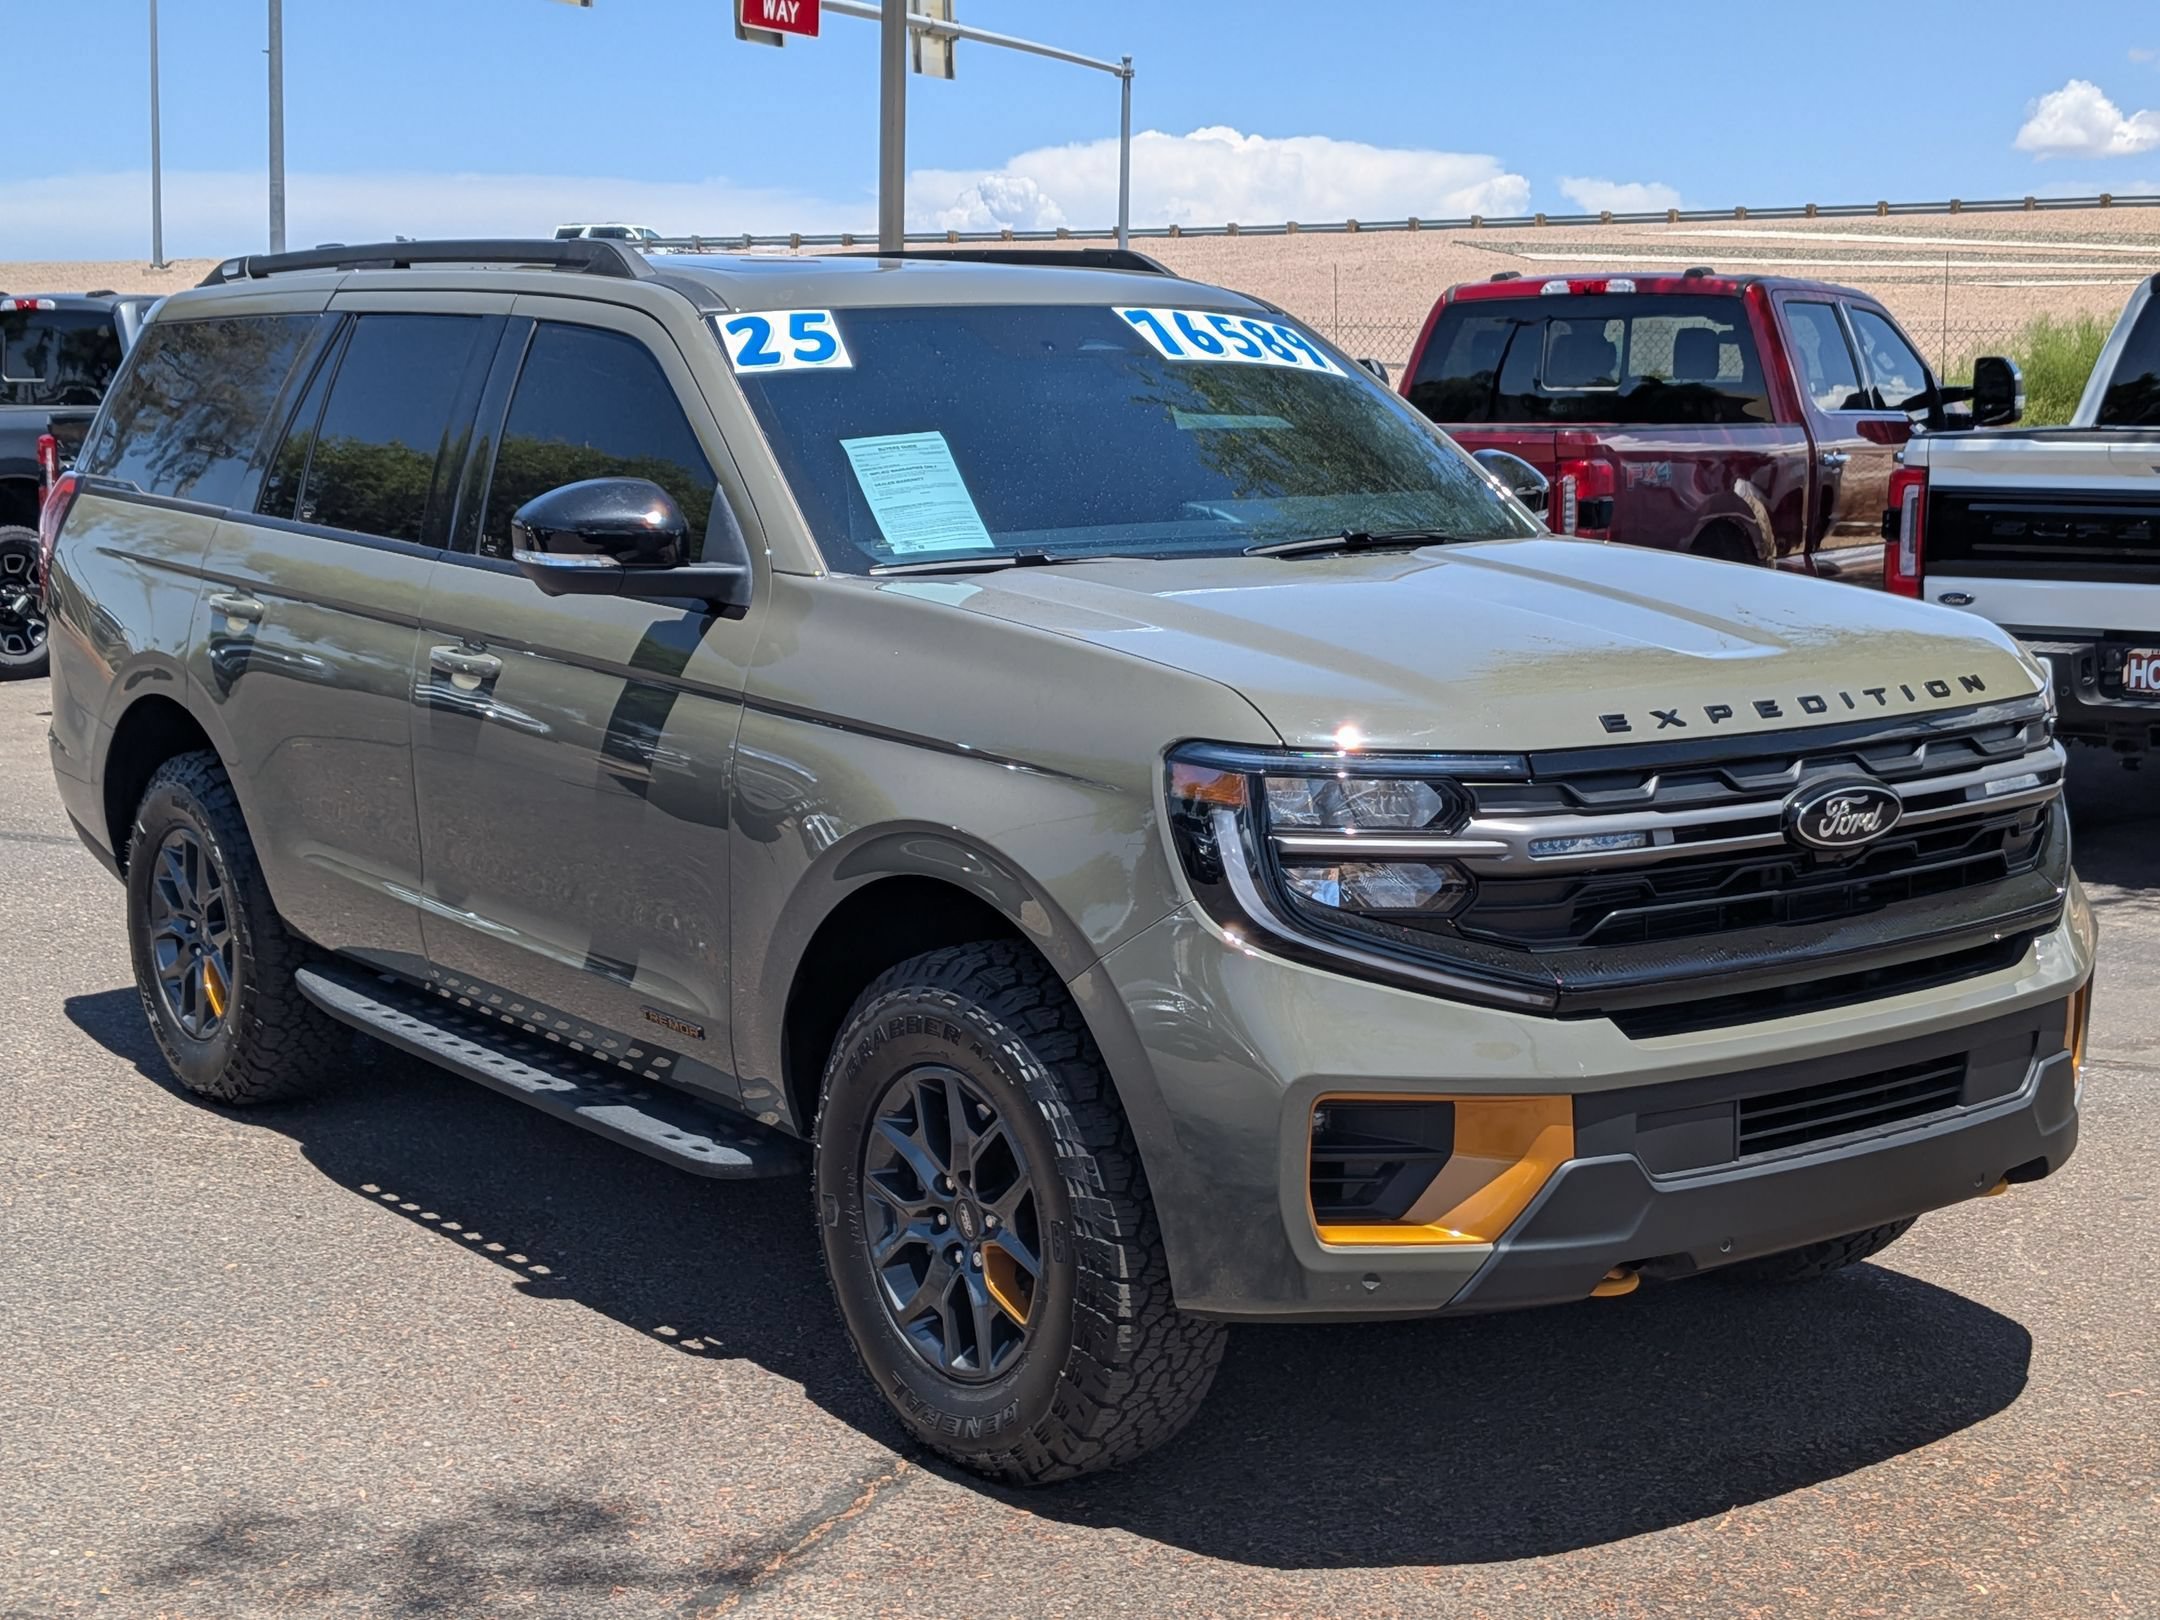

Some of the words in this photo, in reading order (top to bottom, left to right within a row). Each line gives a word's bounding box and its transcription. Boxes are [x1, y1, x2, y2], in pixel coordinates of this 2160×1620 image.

[763, 0, 800, 24] WAY
[725, 313, 837, 367] 25
[1626, 462, 1672, 489] FX4
[1599, 673, 1987, 734] EXPEDITION
[1818, 794, 1885, 838] Ford
